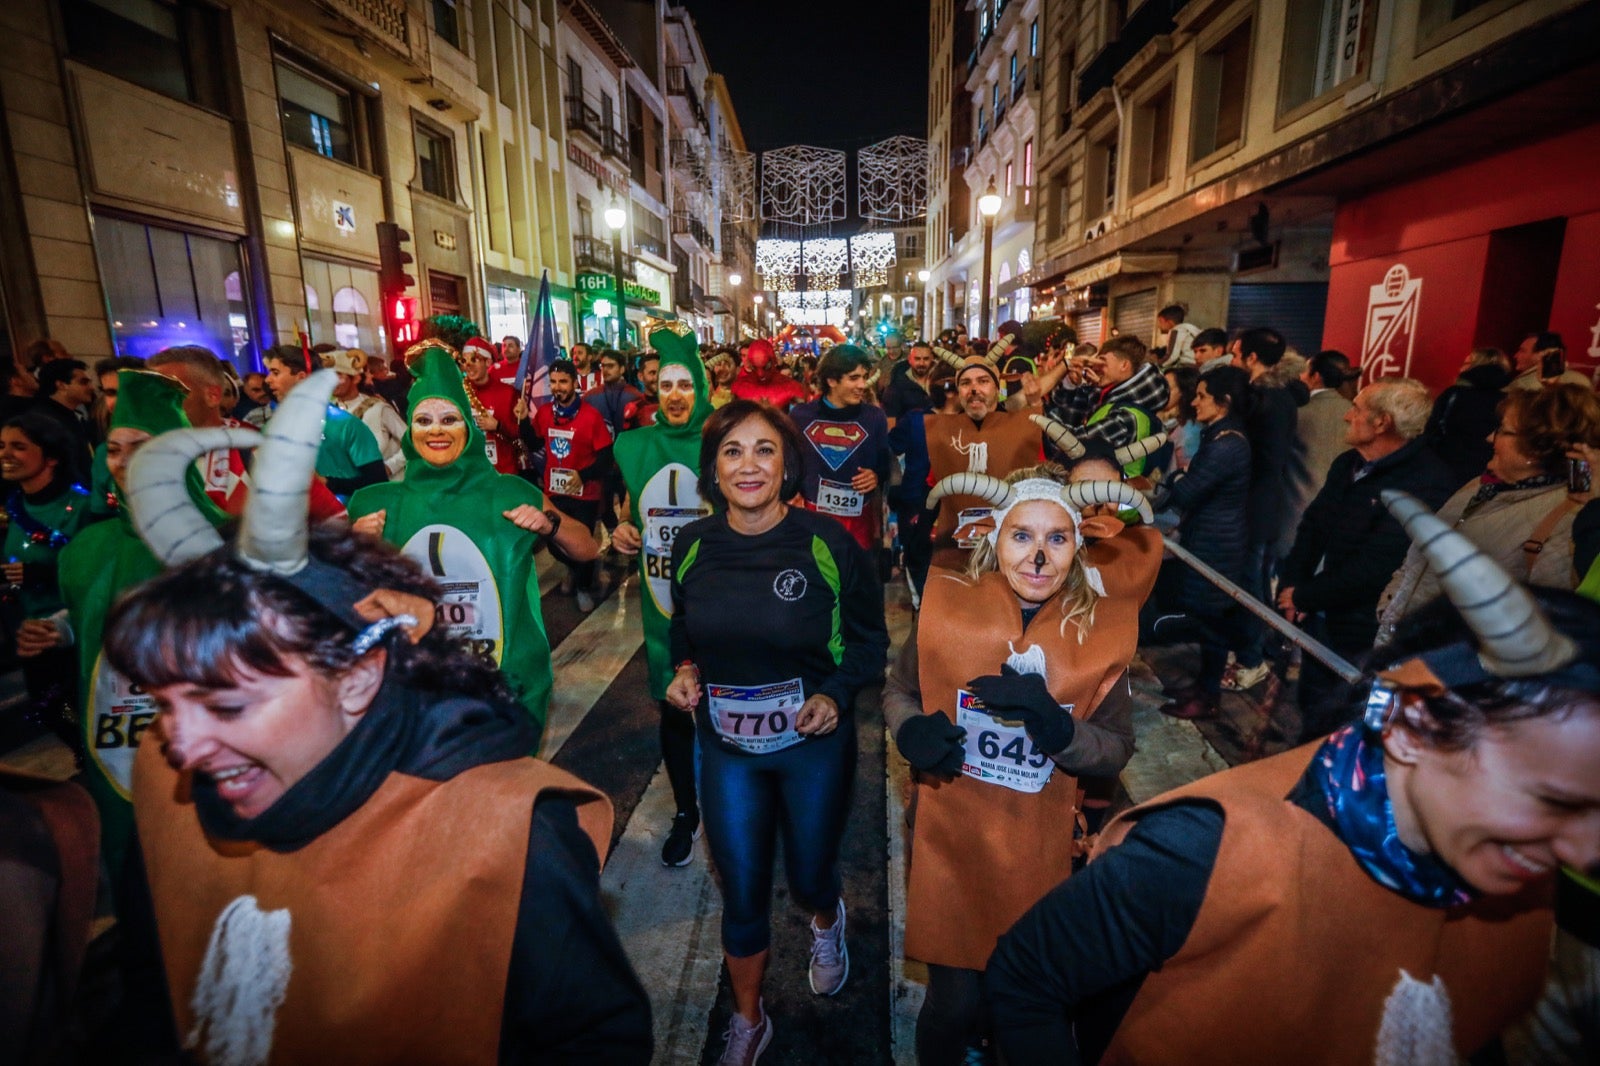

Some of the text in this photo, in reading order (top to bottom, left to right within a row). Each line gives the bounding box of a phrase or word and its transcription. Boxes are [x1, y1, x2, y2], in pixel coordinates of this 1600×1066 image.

[580, 276, 607, 290] 16H
[612, 277, 660, 305] ARMACIA
[825, 494, 858, 507] 1329
[728, 711, 788, 736] 770
[978, 730, 1048, 769] 645
[980, 761, 995, 770] MARIA
